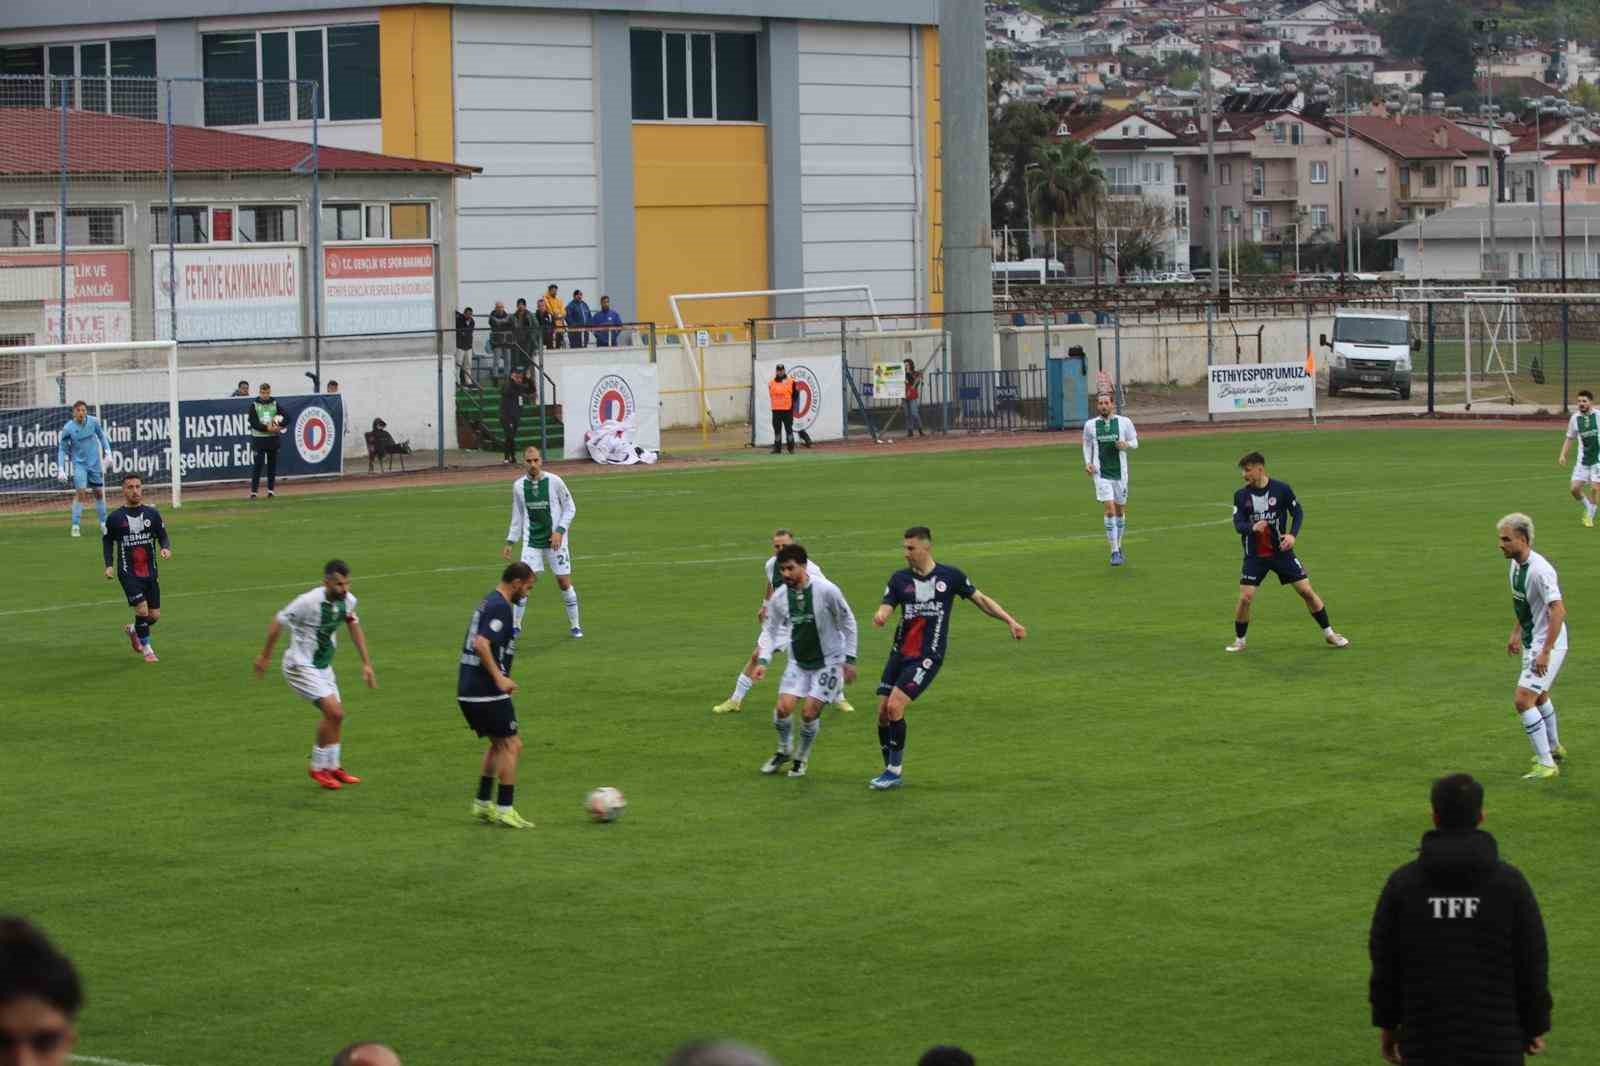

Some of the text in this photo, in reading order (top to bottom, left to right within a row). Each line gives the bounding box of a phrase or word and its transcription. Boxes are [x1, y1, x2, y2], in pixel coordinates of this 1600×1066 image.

[184, 255, 296, 301] FETHİYE KAYMAKAMLIĞI
[18, 423, 63, 448] Lokm
[103, 418, 131, 444] kim
[135, 416, 176, 441] ESNA
[185, 413, 252, 438] HASTANE
[113, 448, 160, 477] Dolayı
[163, 444, 230, 476] Tşekkür
[819, 672, 838, 690] 80
[1428, 897, 1480, 918] TFF
